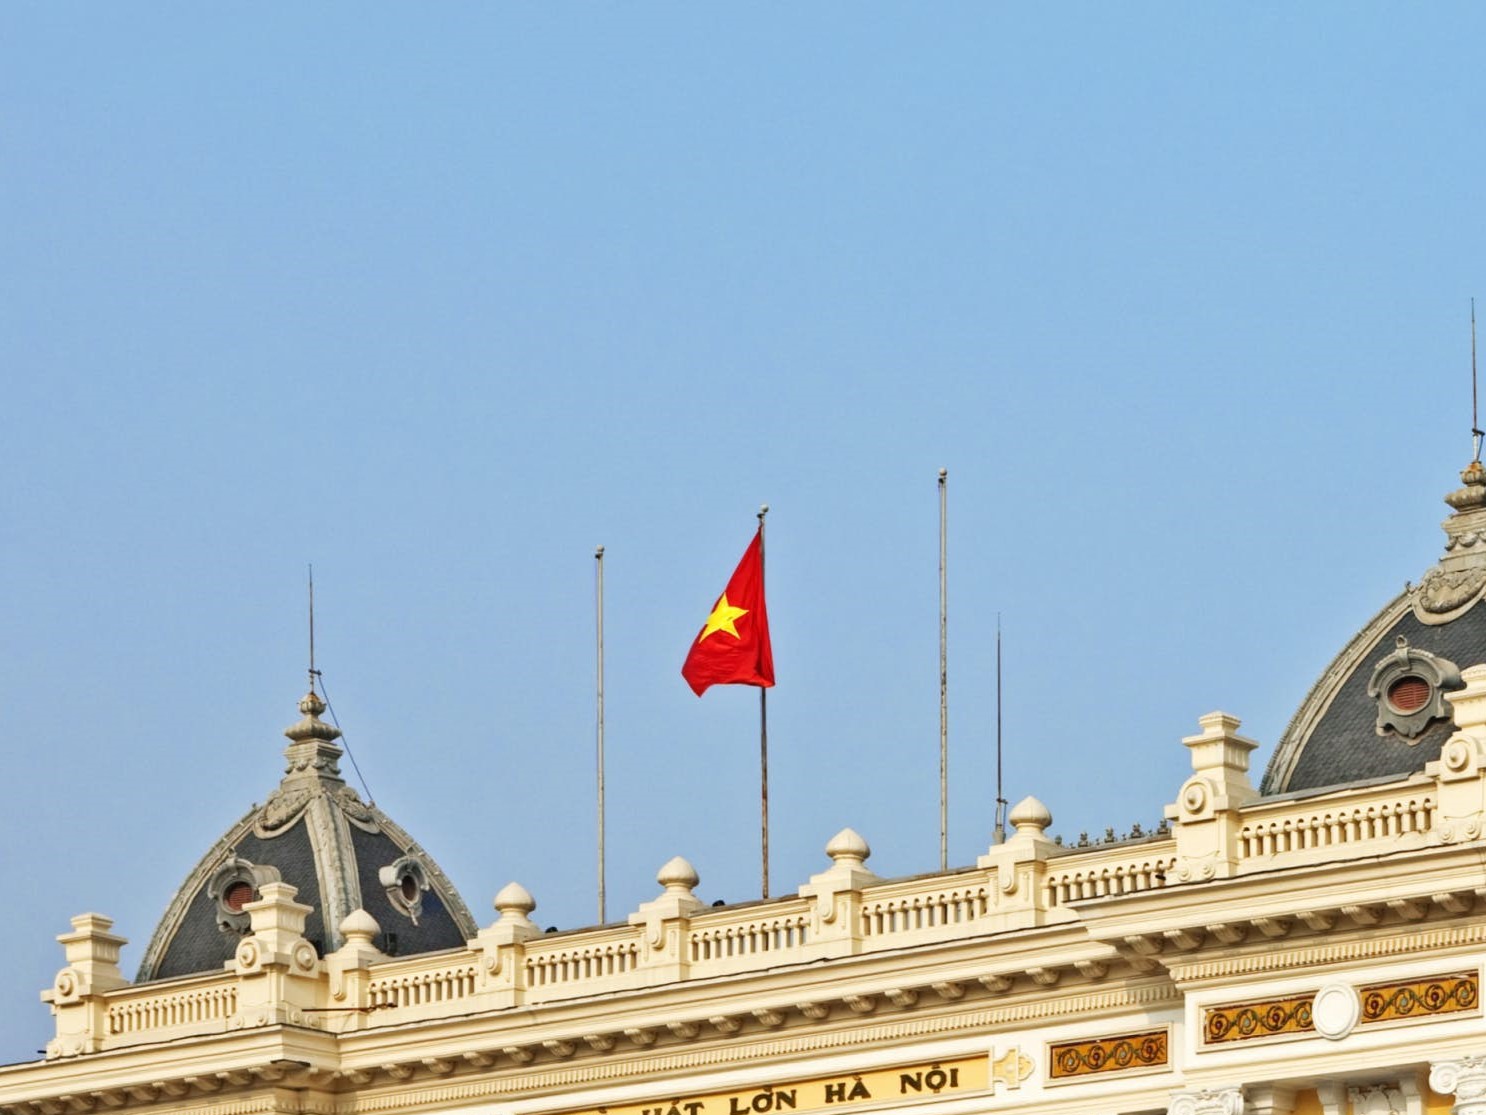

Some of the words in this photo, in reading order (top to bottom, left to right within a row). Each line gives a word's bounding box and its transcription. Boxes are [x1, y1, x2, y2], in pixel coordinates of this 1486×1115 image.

[729, 1085, 797, 1115] LỚN
[825, 1075, 871, 1103] HÀ
[900, 1064, 959, 1094] NỘI
